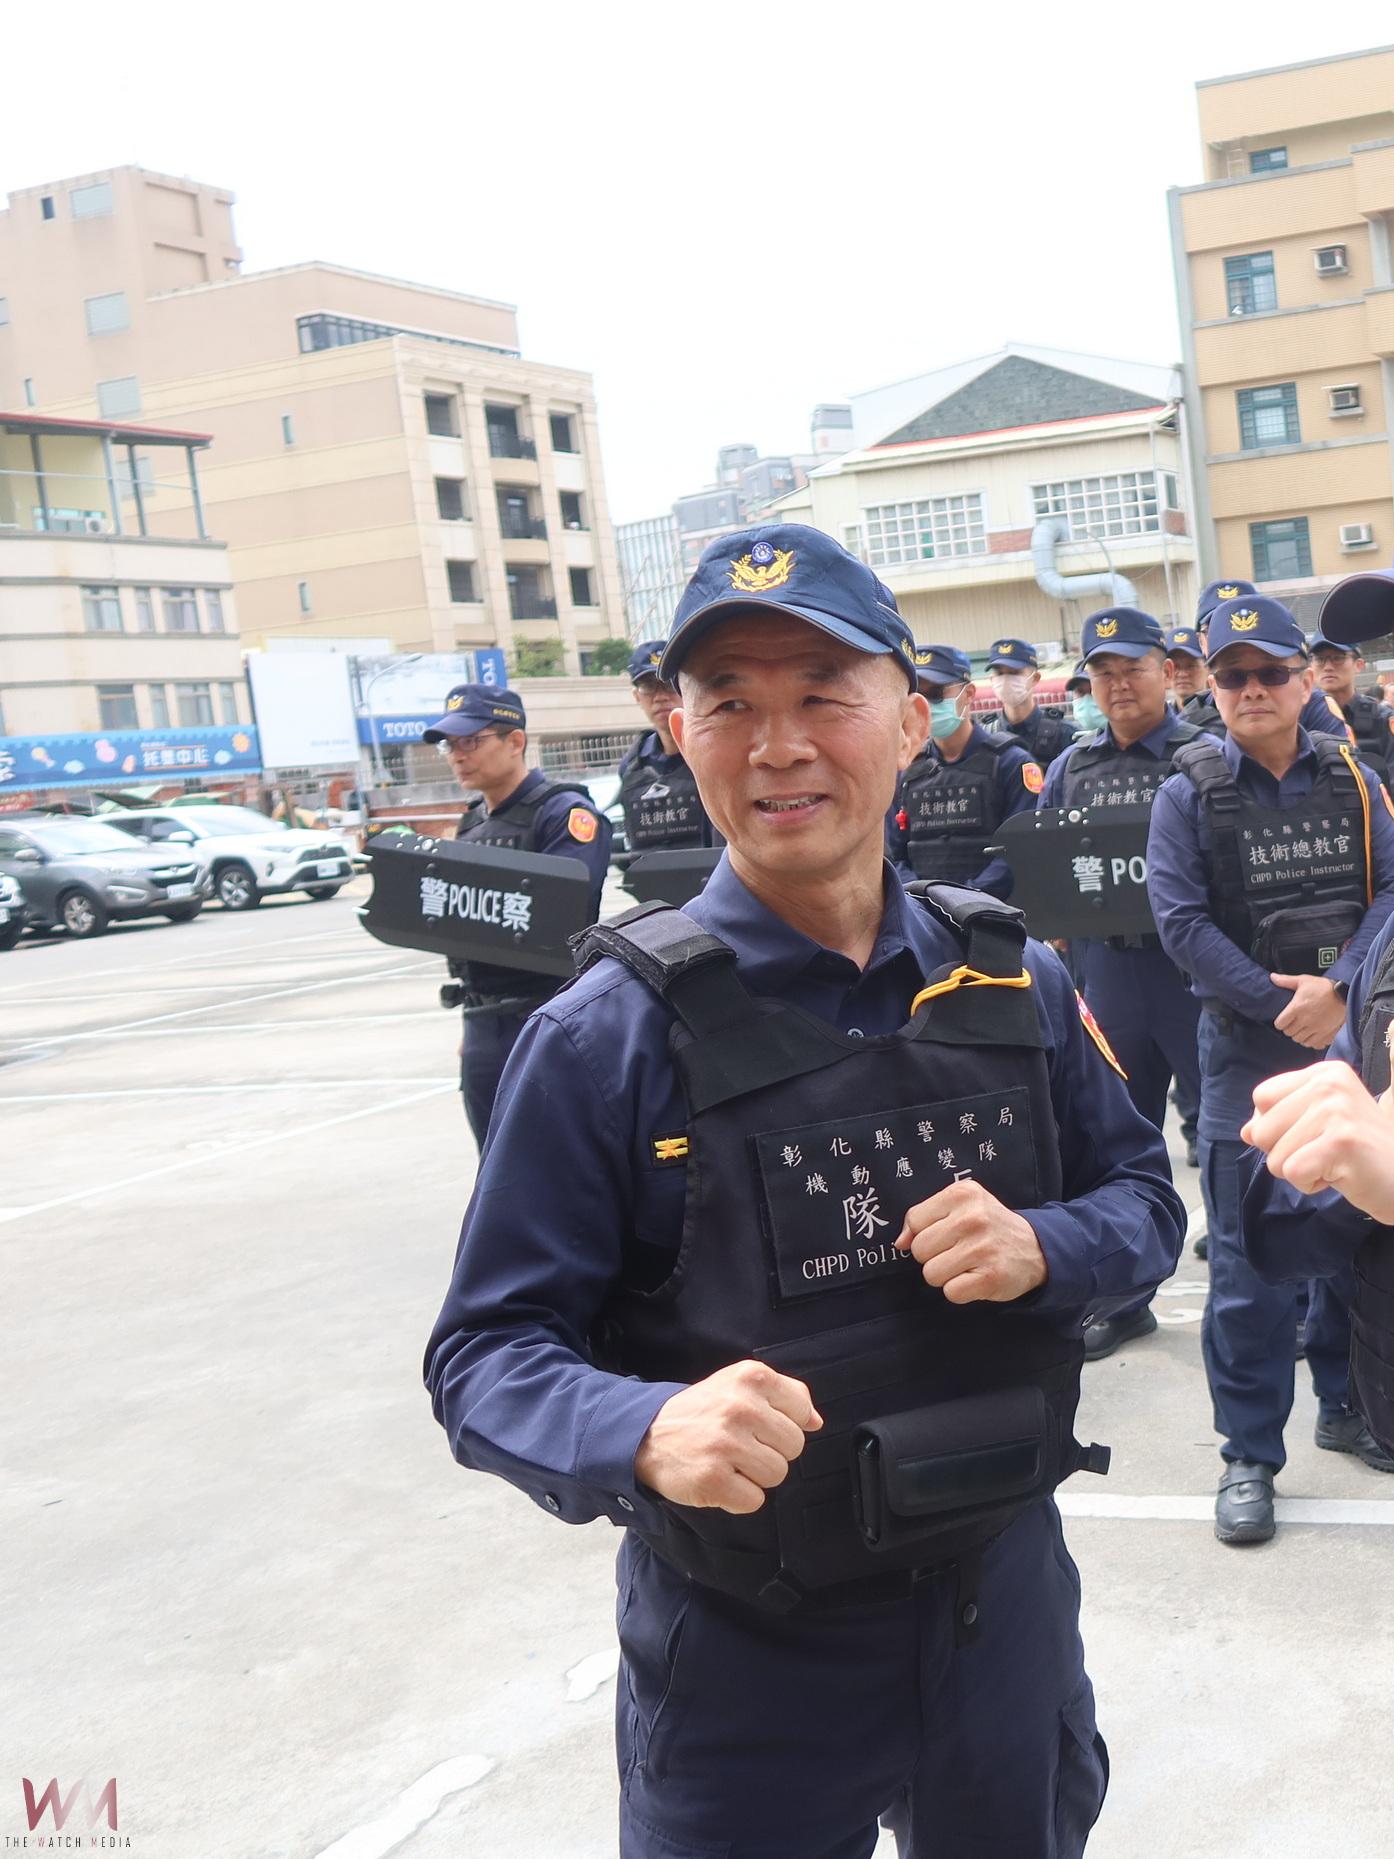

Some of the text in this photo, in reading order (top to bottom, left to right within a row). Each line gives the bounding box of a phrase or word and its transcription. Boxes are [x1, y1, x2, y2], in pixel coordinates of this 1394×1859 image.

[383, 720, 428, 738] TOTO
[919, 798, 969, 816] 技術教官
[1091, 788, 1156, 807] 技術教官
[1249, 834, 1351, 866] 技術總教官
[1072, 856, 1104, 893] 警
[1250, 863, 1355, 884] CHPD Police Instructor
[420, 876, 533, 932] 警 POLICE 察
[779, 1106, 1014, 1168] 彰化縣警察局
[805, 1139, 998, 1196] 機動應變隊
[802, 1253, 850, 1280] CHPD
